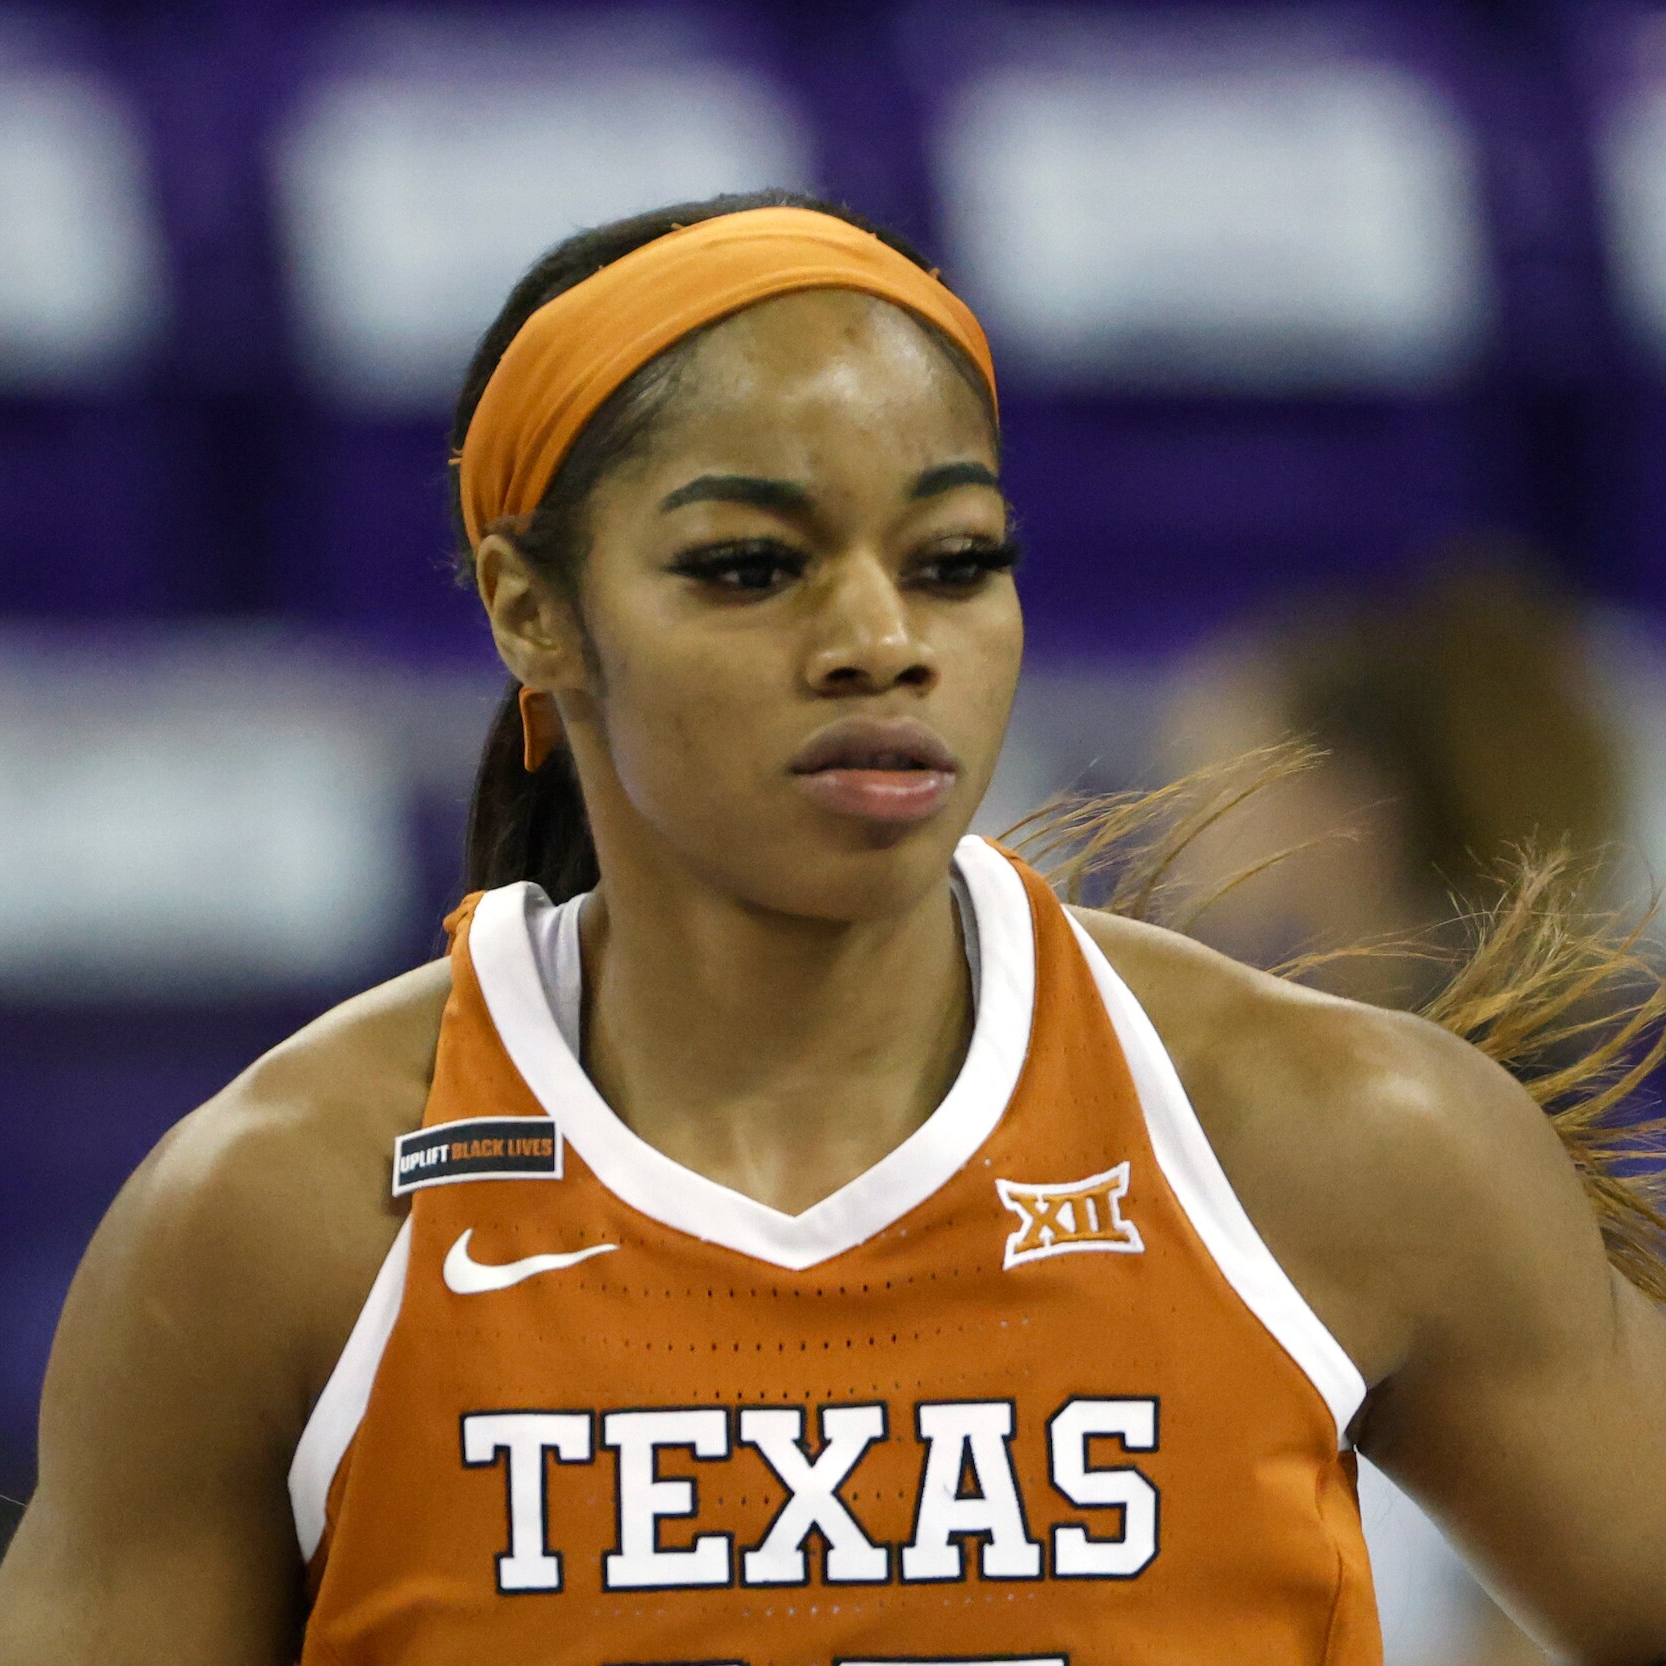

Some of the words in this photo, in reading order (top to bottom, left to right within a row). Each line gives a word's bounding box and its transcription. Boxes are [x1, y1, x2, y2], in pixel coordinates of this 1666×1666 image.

[399, 1143, 449, 1174] UPLIFT
[451, 1138, 504, 1160] BLACK
[507, 1137, 553, 1158] LIVES
[460, 1396, 1161, 1594] TEXAS
